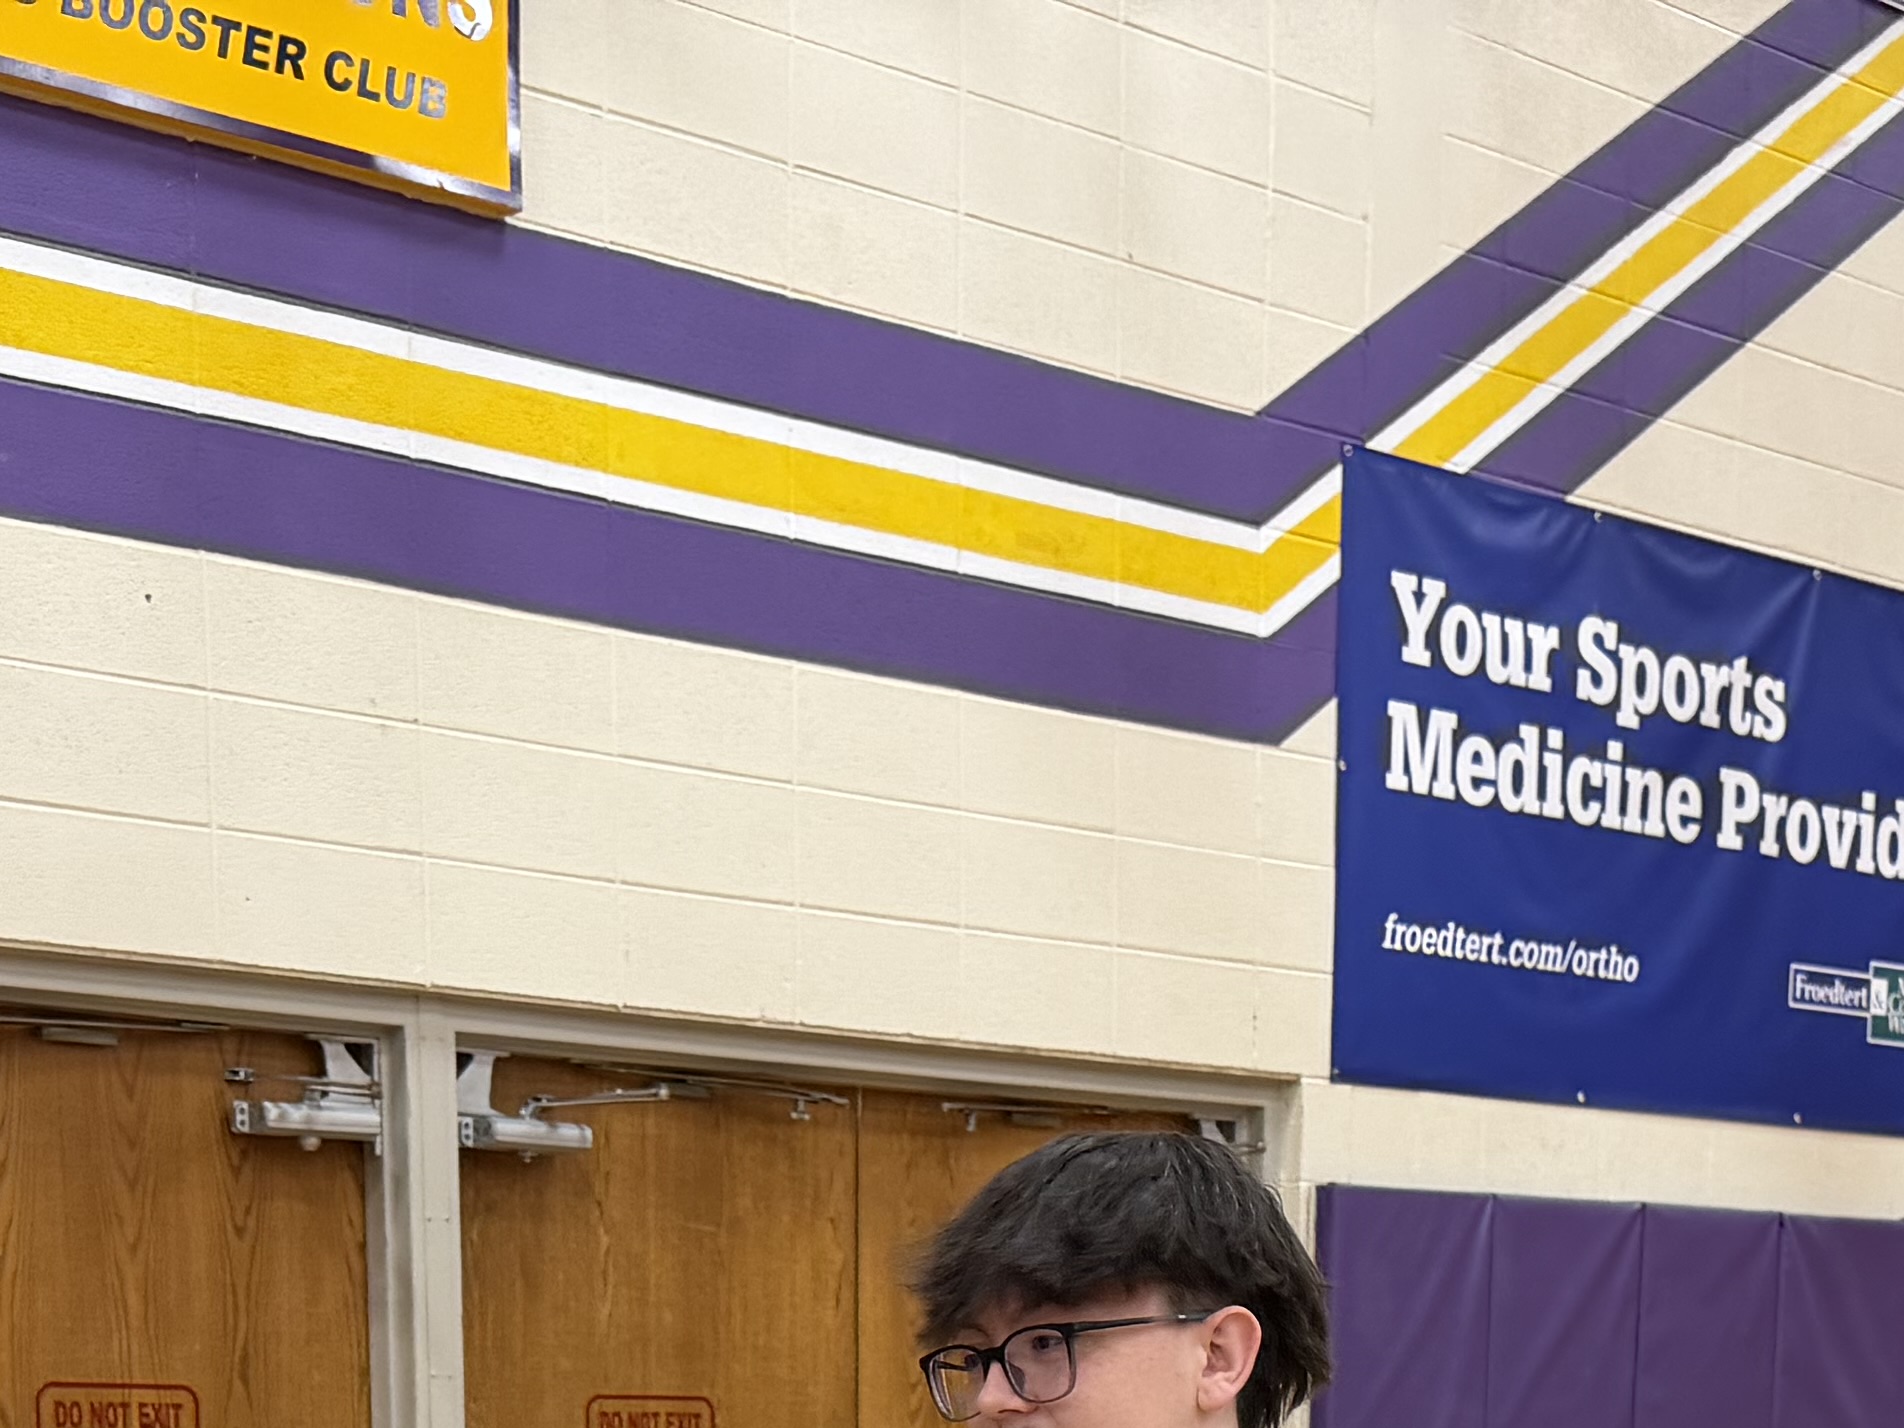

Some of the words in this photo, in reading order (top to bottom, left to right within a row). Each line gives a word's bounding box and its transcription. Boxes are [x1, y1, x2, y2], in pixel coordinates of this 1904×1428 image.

[323, 50, 449, 119] CLUB
[1390, 570, 1560, 692] Your
[1576, 615, 1788, 743] Sports
[1385, 700, 1702, 845] Medicine
[1381, 913, 1641, 984] froedtert.com/ortho
[1795, 973, 1868, 1008] Froedtert
[53, 1400, 83, 1428] DO
